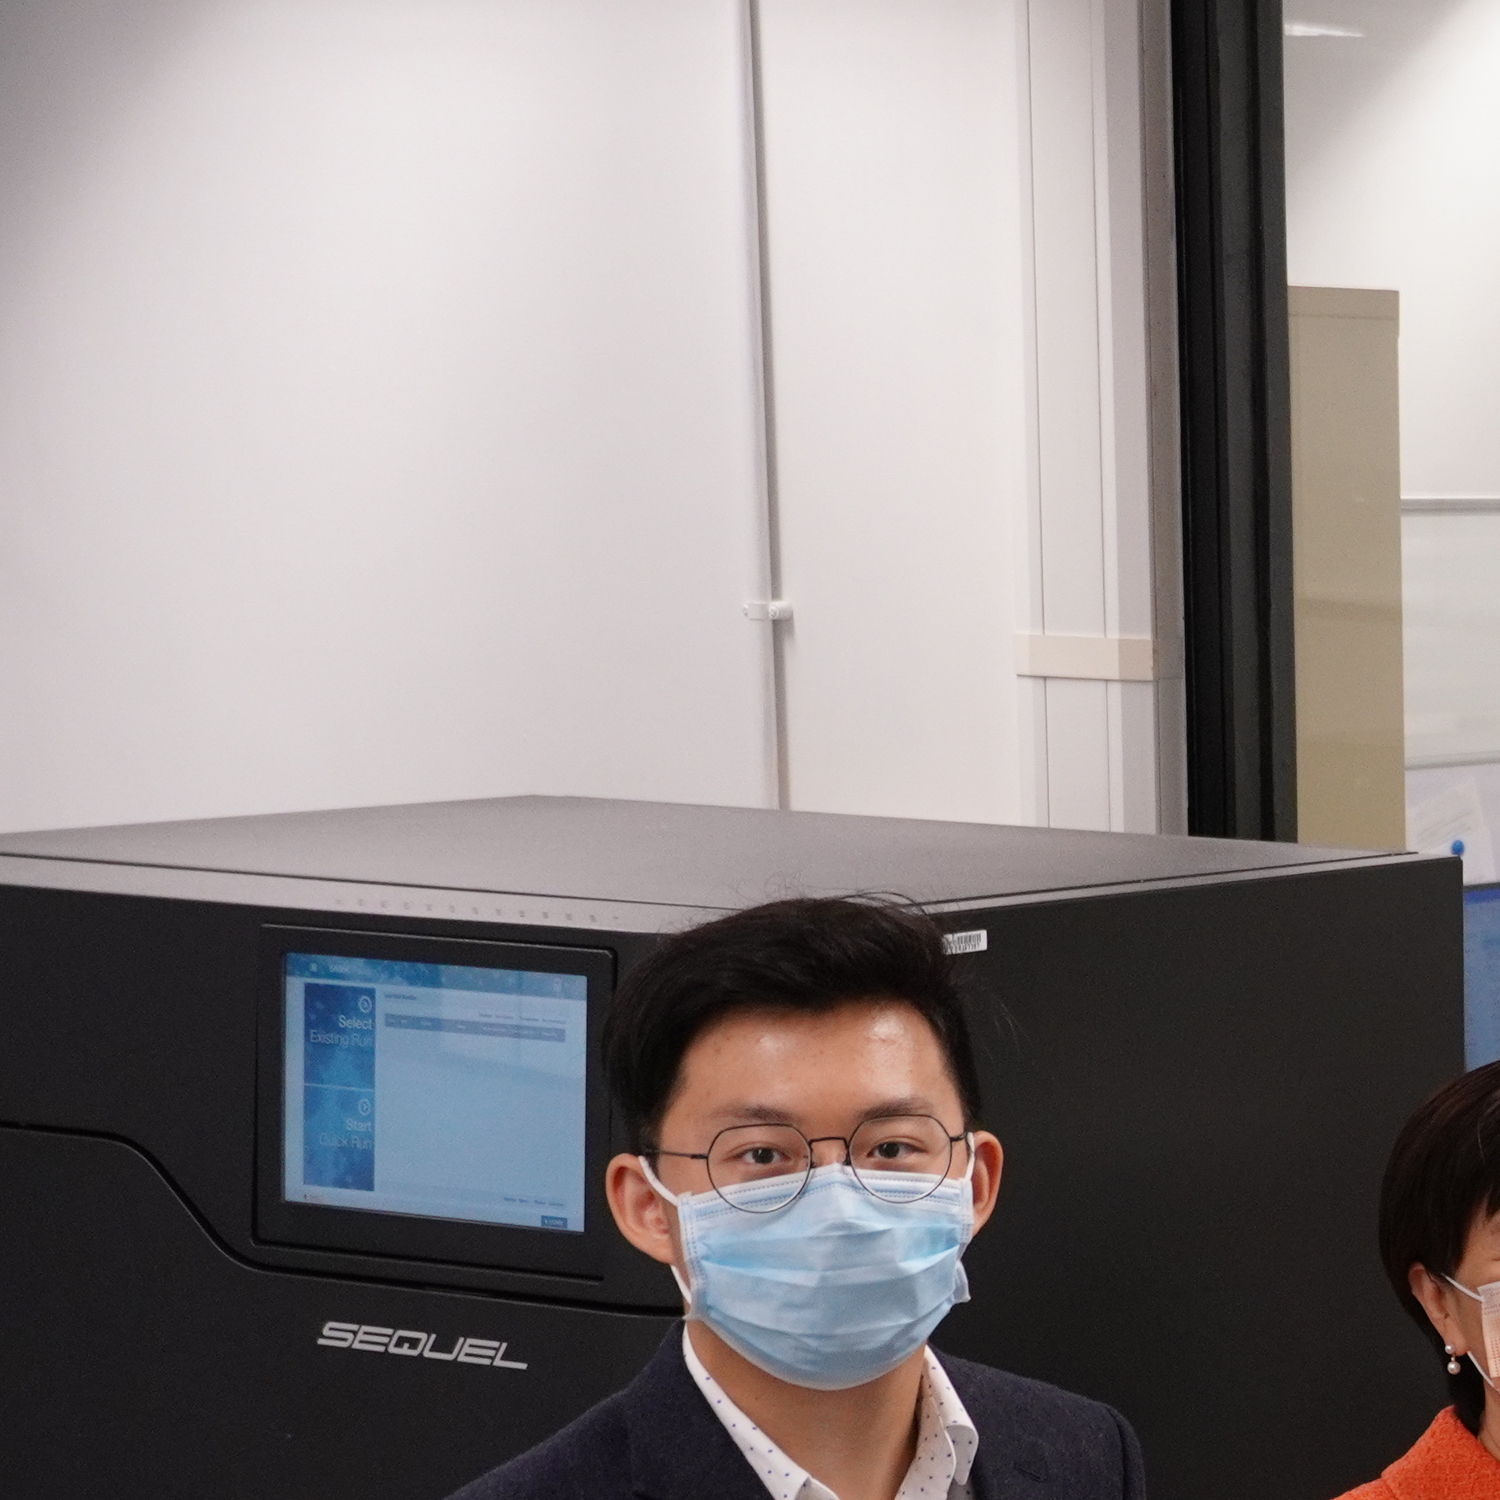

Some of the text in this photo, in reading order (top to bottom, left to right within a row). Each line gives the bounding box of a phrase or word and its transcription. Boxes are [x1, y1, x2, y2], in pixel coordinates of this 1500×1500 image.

[338, 1015, 373, 1031] Select
[309, 1029, 349, 1047] Existing
[345, 1119, 372, 1132] Start
[319, 1131, 348, 1149] Quick
[317, 1321, 528, 1370] SEQUEL
